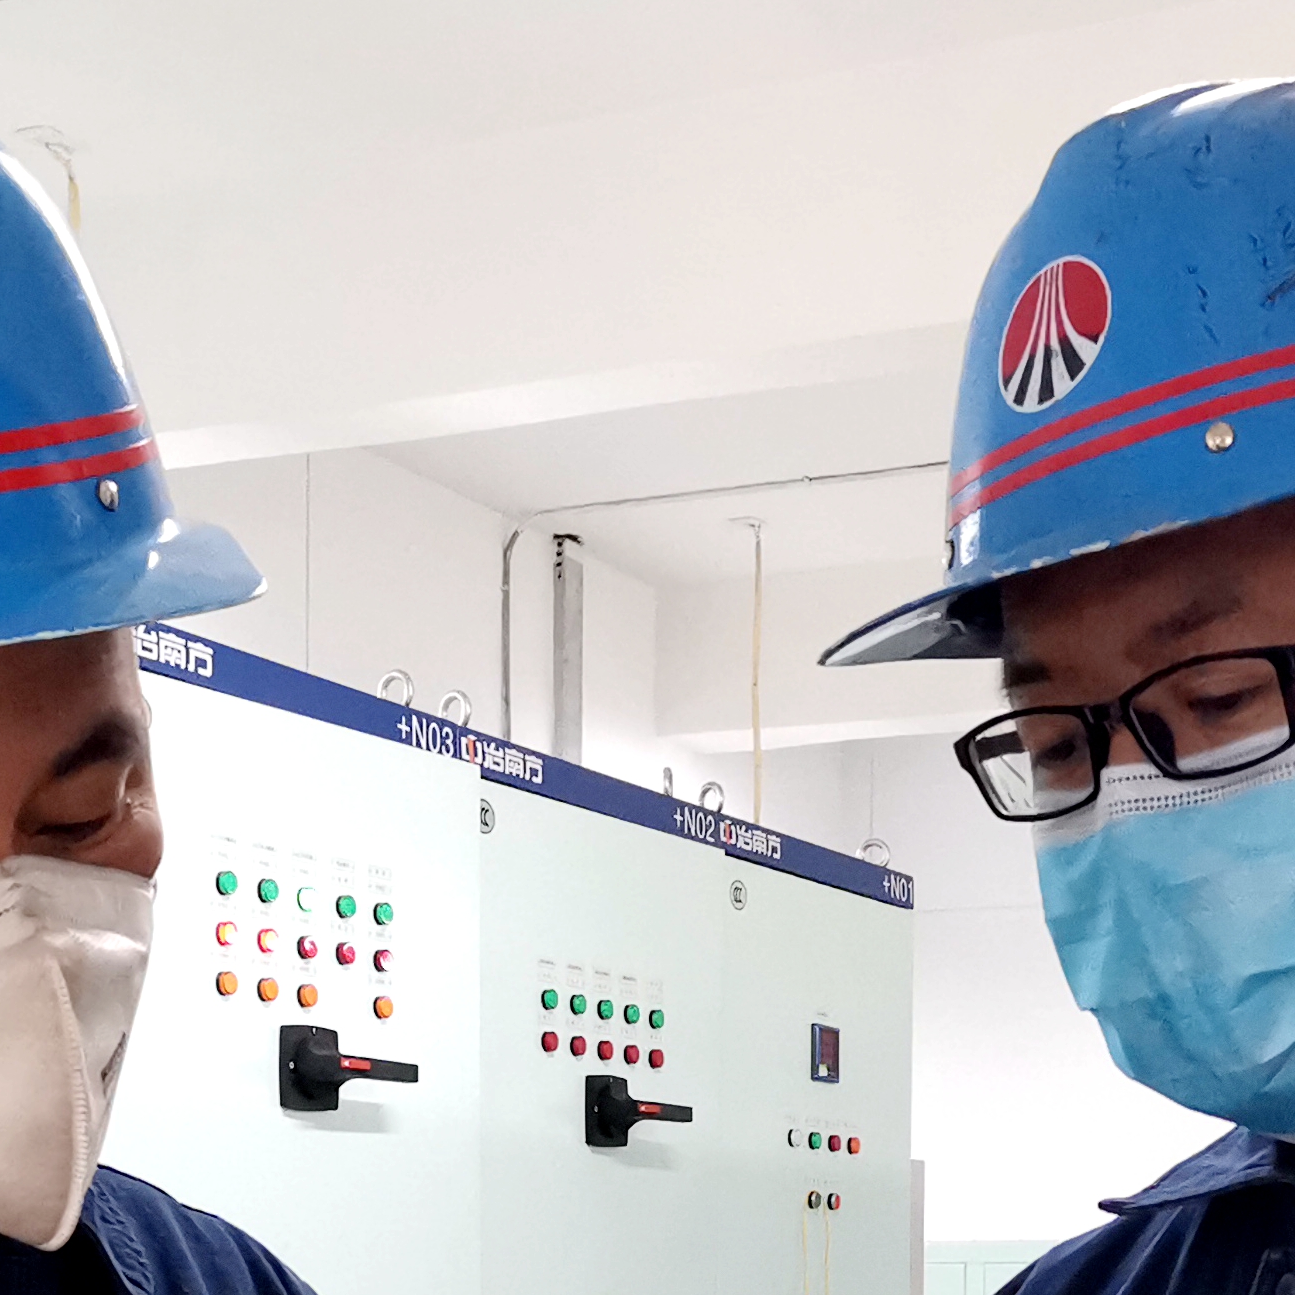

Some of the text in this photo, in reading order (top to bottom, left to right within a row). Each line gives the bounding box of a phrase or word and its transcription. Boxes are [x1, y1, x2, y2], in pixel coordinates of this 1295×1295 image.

[397, 714, 454, 758] +N03
[460, 734, 543, 784] 中冶南方
[673, 806, 715, 842] +N02
[719, 819, 781, 859] 中冶南方
[882, 873, 913, 904] +N01
